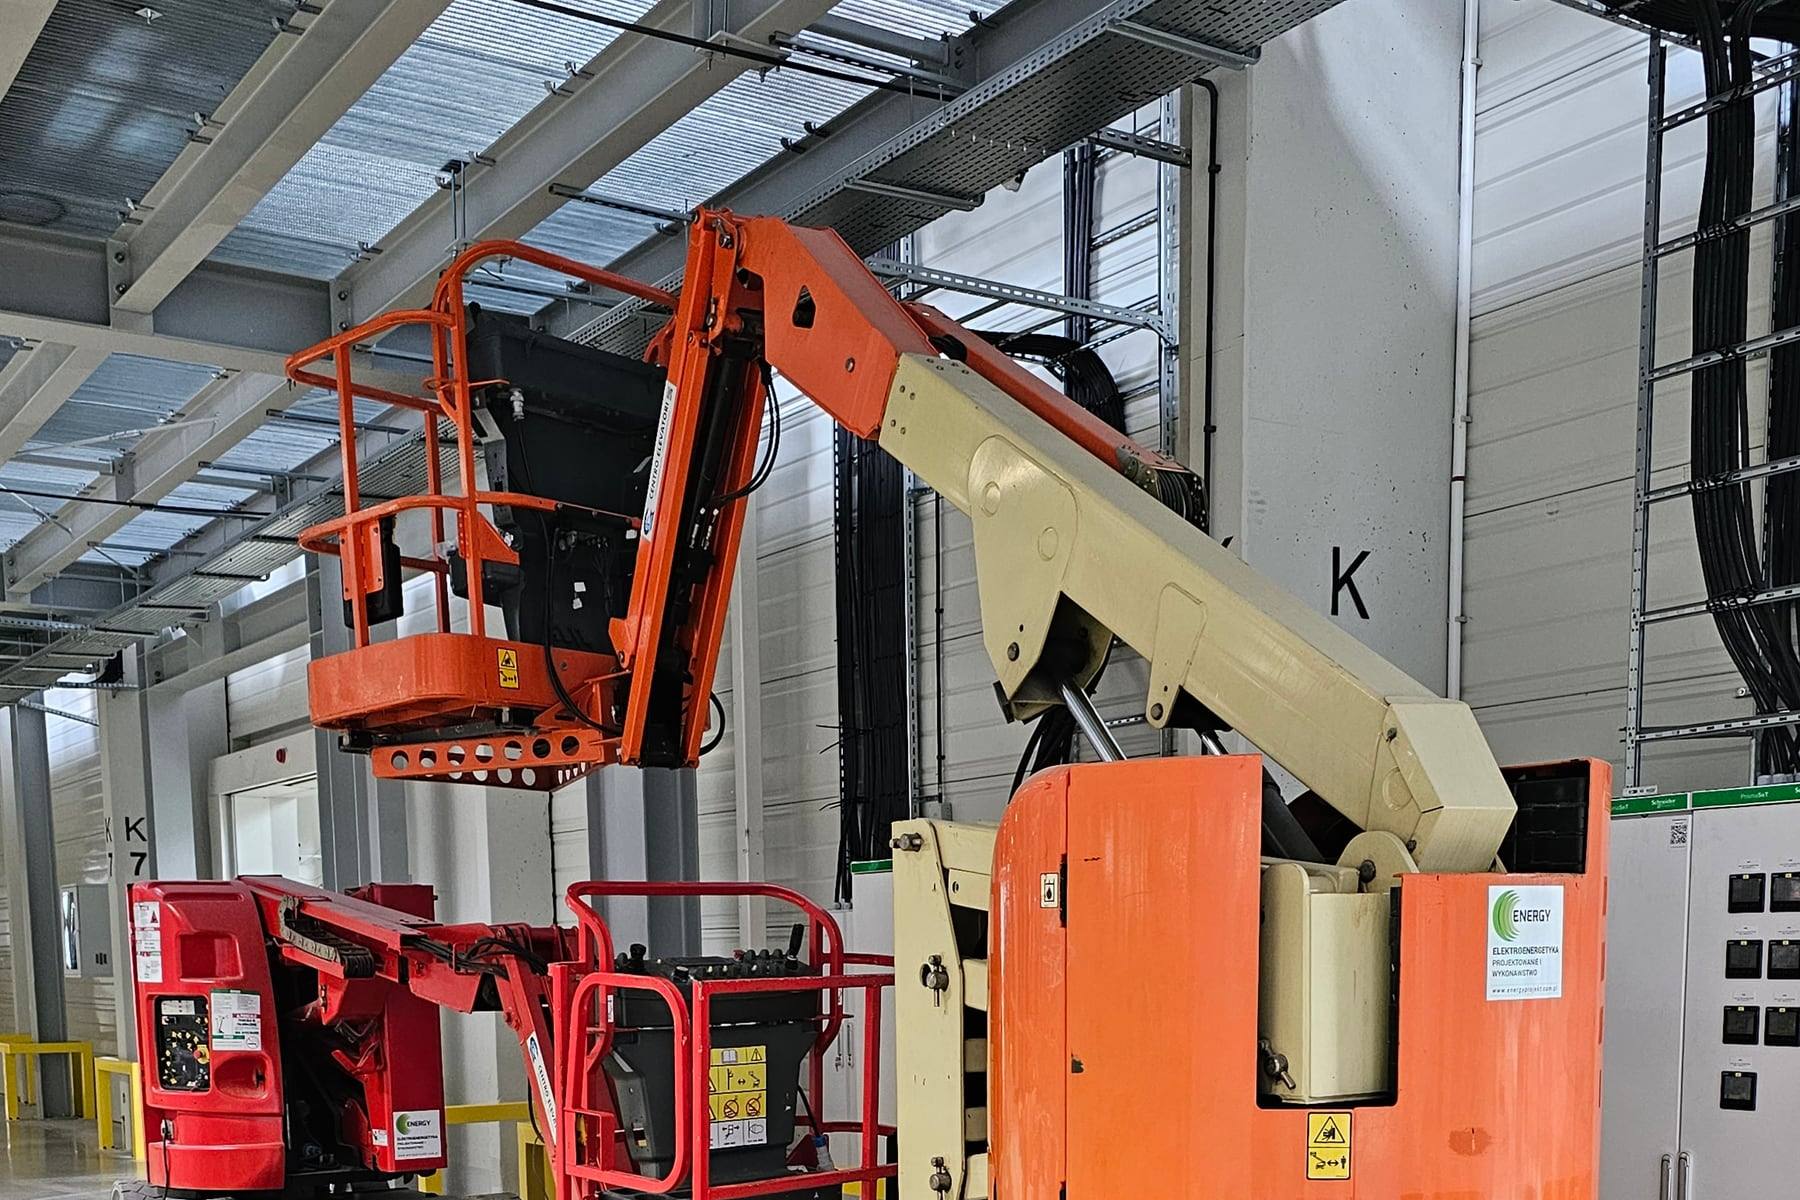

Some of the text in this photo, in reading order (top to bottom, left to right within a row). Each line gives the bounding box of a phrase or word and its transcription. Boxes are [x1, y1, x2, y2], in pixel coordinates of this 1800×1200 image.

[650, 459, 660, 499] CENTRO
[656, 402, 670, 457] ELEVATORI
[1331, 546, 1371, 620] K
[125, 816, 147, 842] K
[130, 852, 147, 876] 7
[1513, 910, 1551, 922] ENERGY
[1492, 947, 1559, 956] ELEKTROENERGETYKA
